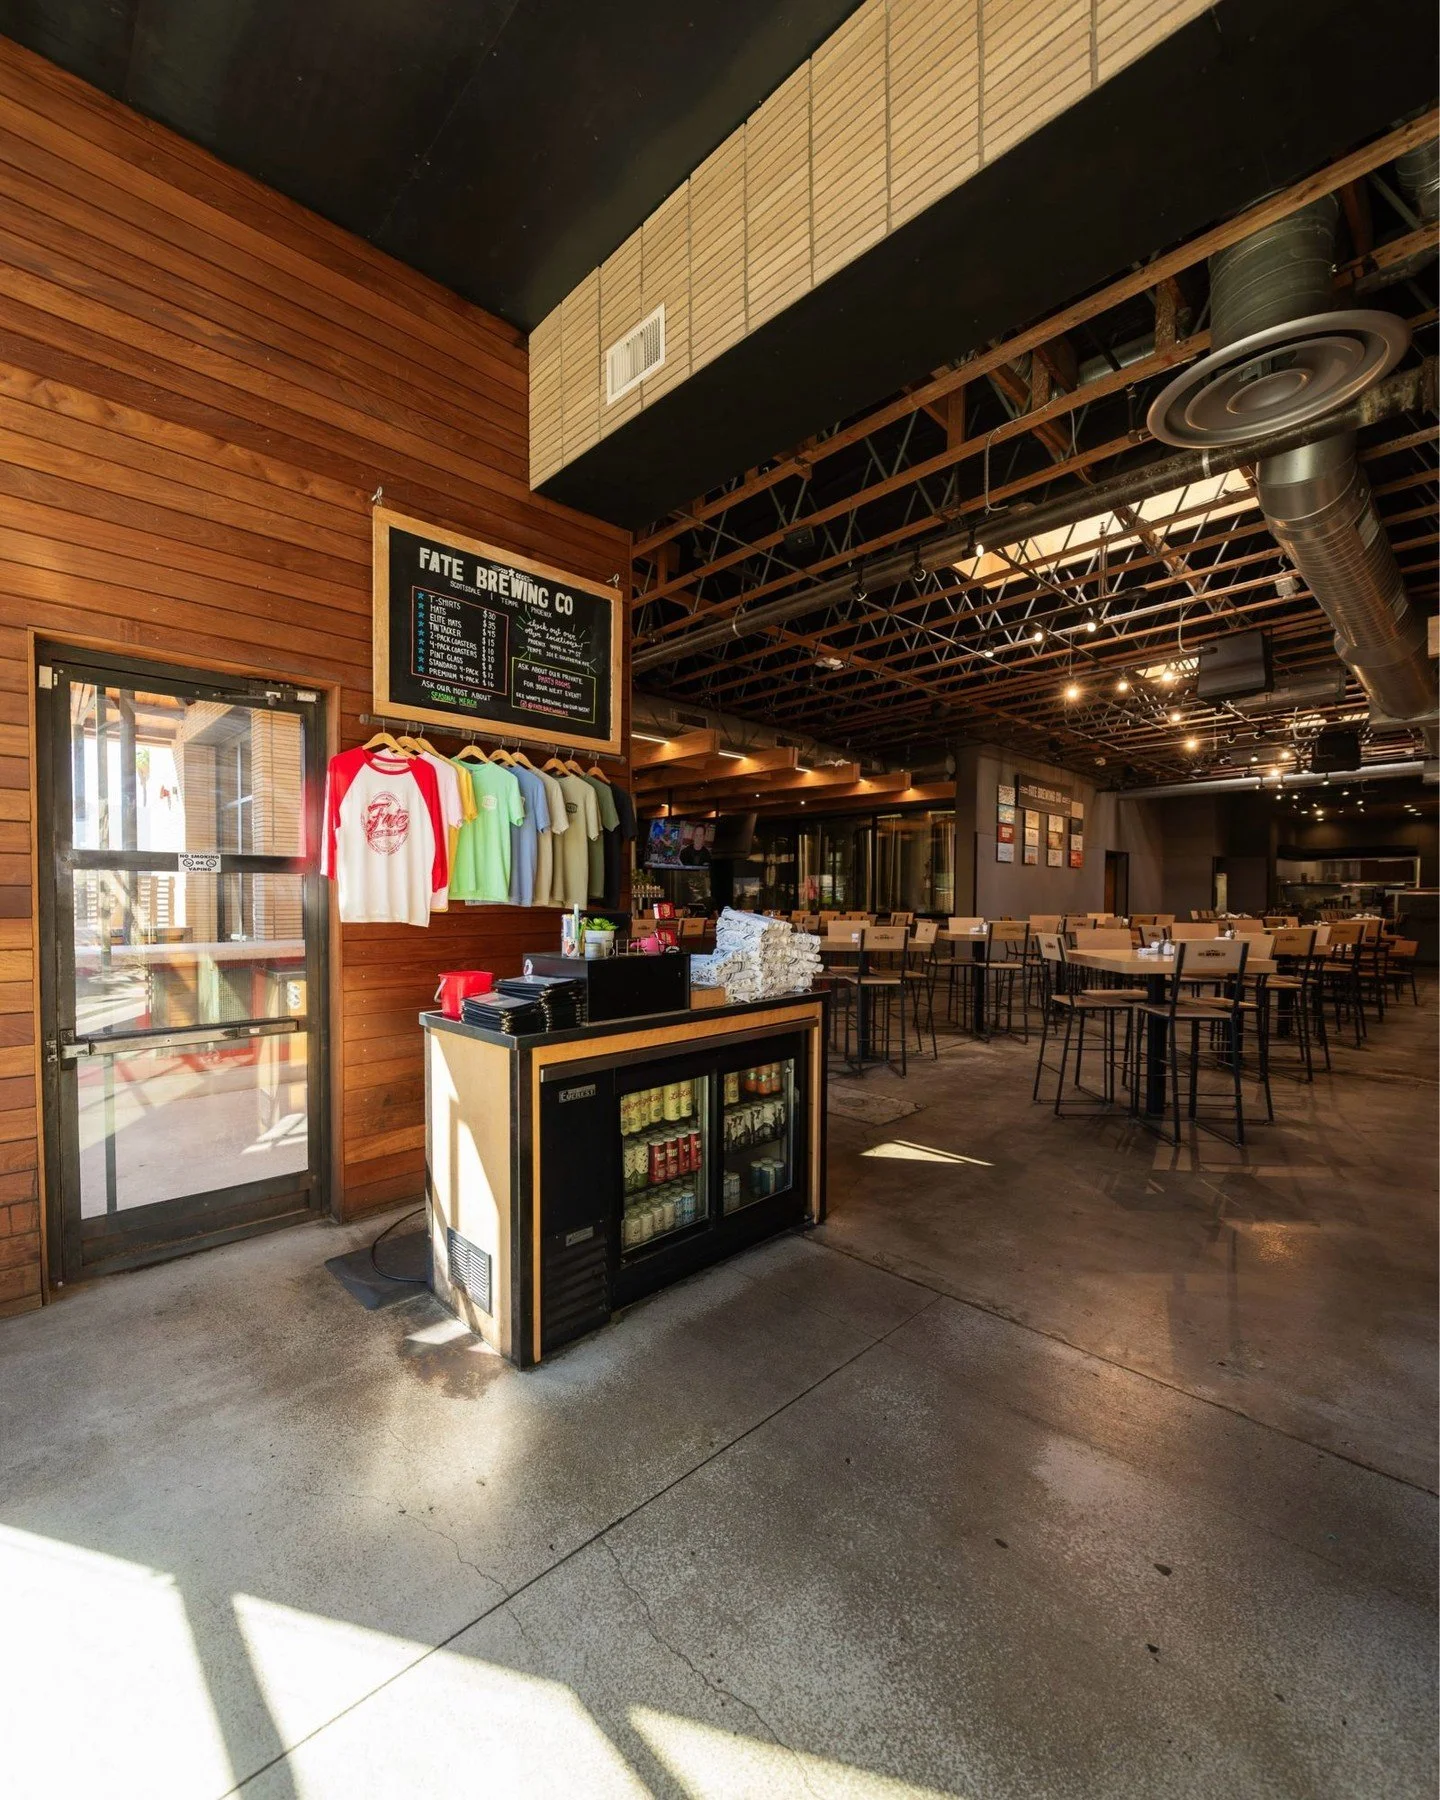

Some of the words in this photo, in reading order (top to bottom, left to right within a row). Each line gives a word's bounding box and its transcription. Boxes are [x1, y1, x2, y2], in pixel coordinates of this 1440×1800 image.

[419, 547, 464, 581] FATE
[476, 566, 549, 608] BREWING
[555, 592, 573, 615] CO
[428, 594, 461, 610] T-SHIRTS
[483, 609, 496, 620] $30
[450, 580, 481, 596] SCOTTSDALE
[501, 597, 519, 608] TEMPE
[531, 606, 552, 618] PHOENIX
[430, 604, 447, 616] HATS
[428, 621, 440, 632] TIN
[439, 623, 461, 638] TACKER
[429, 613, 446, 625] ELITE
[447, 618, 462, 629] HATS
[429, 640, 451, 652] 4-PACK
[451, 646, 477, 658] COASTERS
[430, 631, 451, 643] 2-PACK
[451, 638, 477, 651] COASTERS
[429, 649, 444, 659] PINT
[446, 653, 464, 664] GLASS
[428, 658, 457, 671] STANDARD
[459, 665, 479, 676] 4-PACK
[428, 667, 457, 680] PREMIUM
[459, 674, 479, 684] 4-PACK
[517, 662, 529, 671] ASK
[531, 666, 548, 675] ABOUT
[548, 670, 561, 679] OUR
[562, 673, 583, 685] PRIVATE
[421, 680, 435, 689] ASK
[436, 684, 451, 693] OUR
[452, 687, 468, 697] HOST
[471, 692, 492, 701] ABOUT
[523, 680, 534, 689] FOR
[548, 687, 563, 695] NEXT
